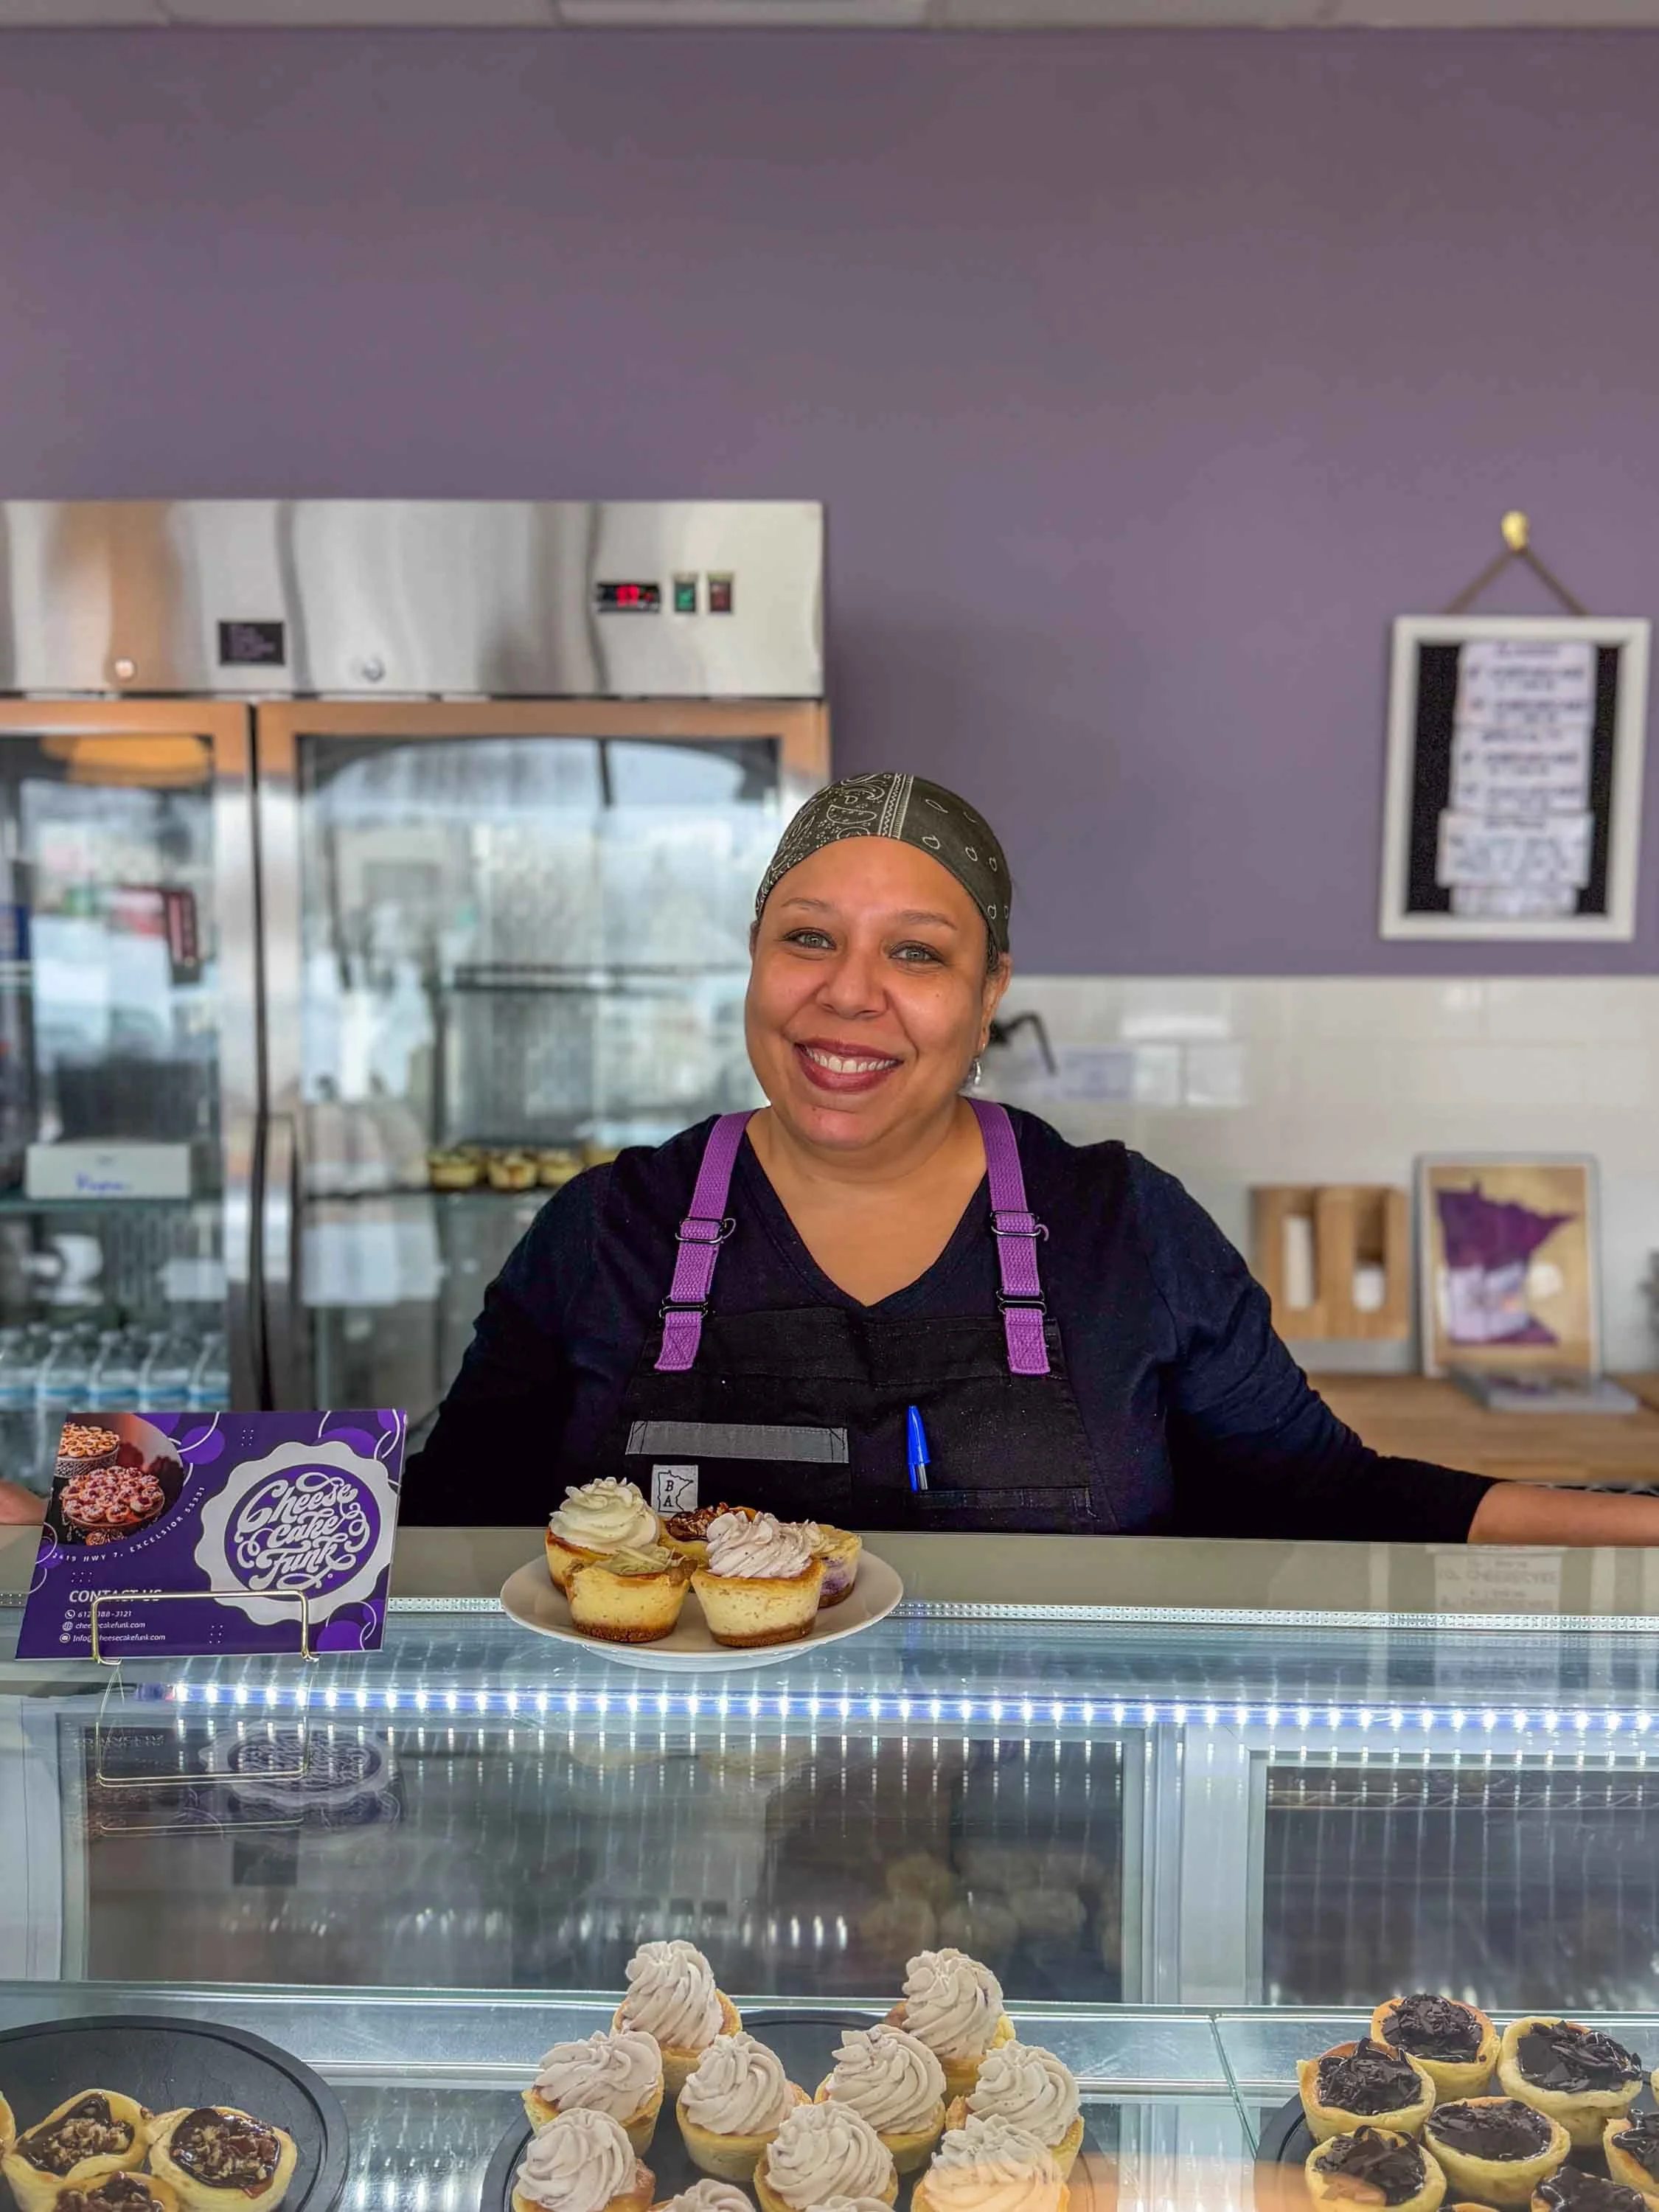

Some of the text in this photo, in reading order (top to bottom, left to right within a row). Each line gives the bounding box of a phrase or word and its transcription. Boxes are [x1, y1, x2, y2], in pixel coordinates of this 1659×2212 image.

[234, 1472, 358, 1544] Cheese
[663, 1495, 675, 1507] A
[664, 1480, 675, 1492] B
[83, 1554, 106, 1562] HWY
[129, 1516, 184, 1553] EXCELSIOR
[184, 1486, 205, 1513] 55331
[249, 1531, 357, 1590] Funk
